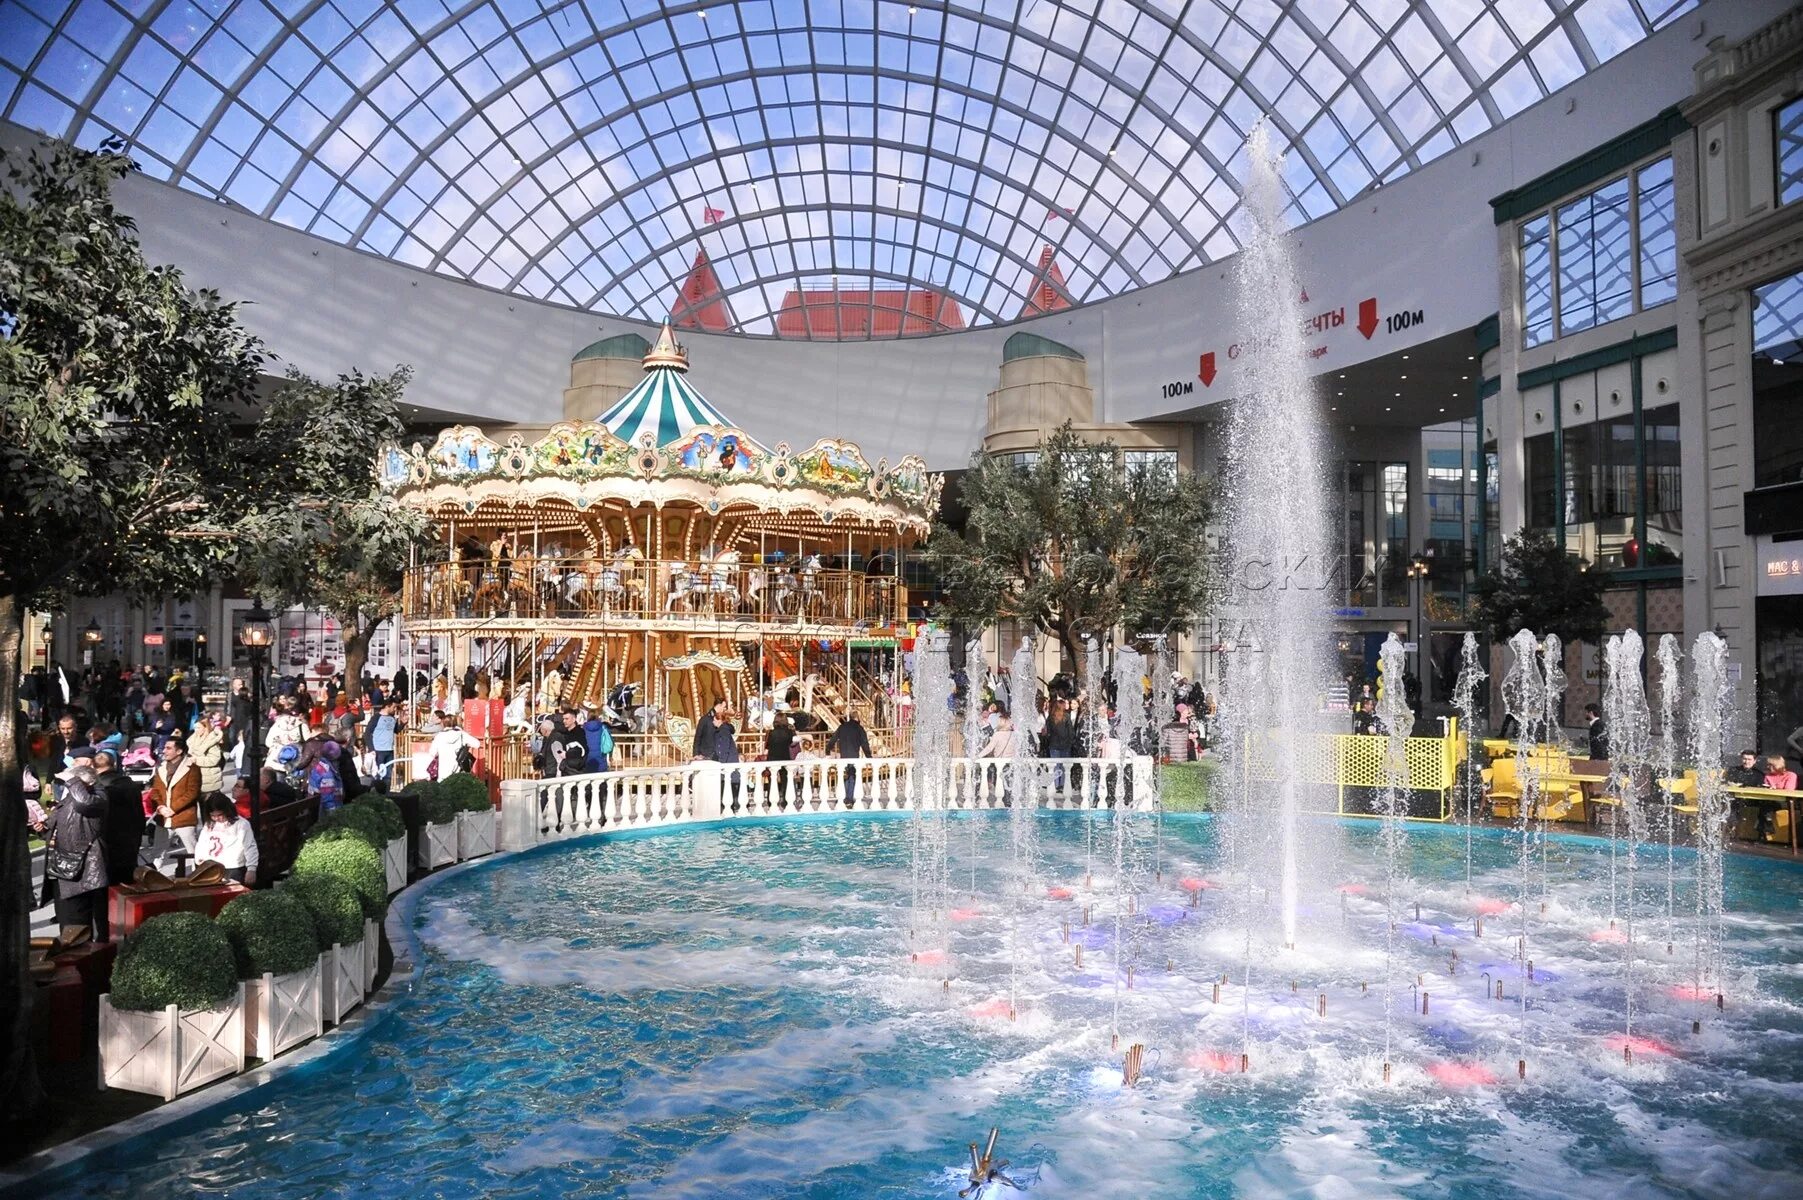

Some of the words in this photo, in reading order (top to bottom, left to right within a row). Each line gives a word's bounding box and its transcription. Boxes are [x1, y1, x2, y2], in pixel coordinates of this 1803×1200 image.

[1386, 310, 1424, 334] 100м
[1162, 382, 1193, 399] 100м
[1768, 561, 1788, 573] MAC
